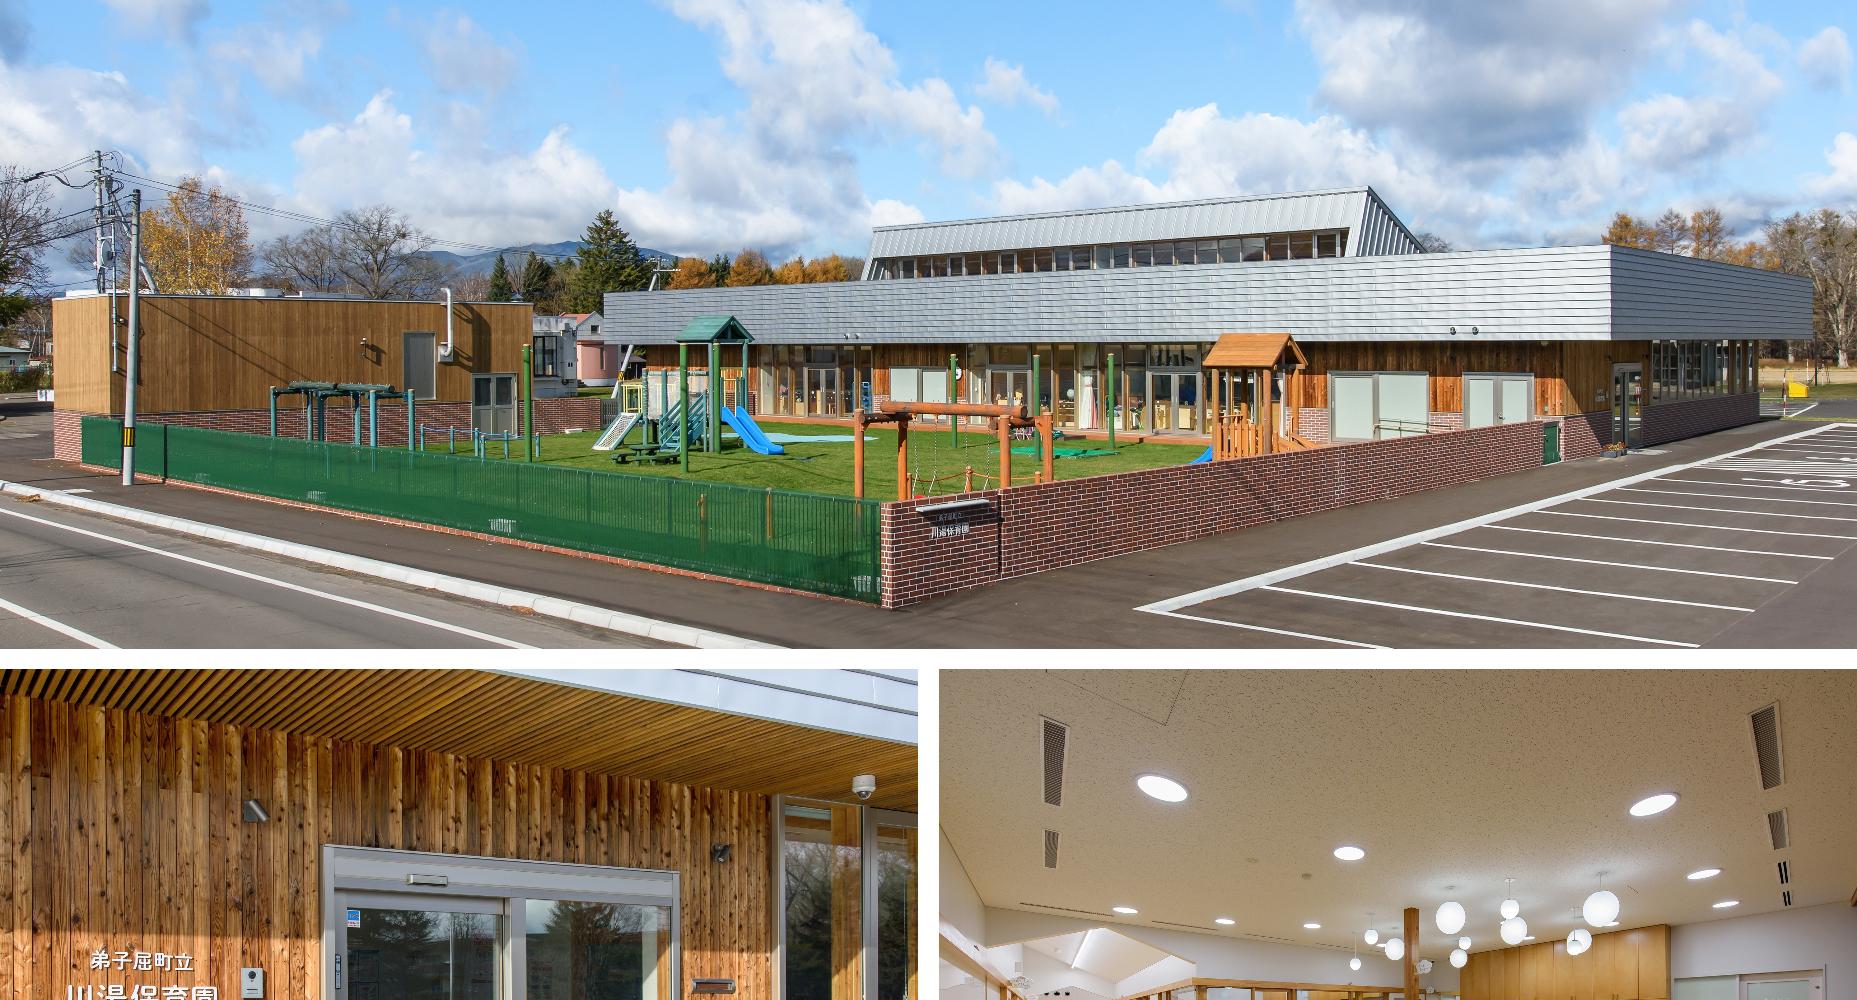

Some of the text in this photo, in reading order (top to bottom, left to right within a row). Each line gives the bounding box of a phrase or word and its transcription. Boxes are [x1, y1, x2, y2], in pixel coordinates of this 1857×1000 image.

[90, 950, 193, 971] 弟子屈町立
